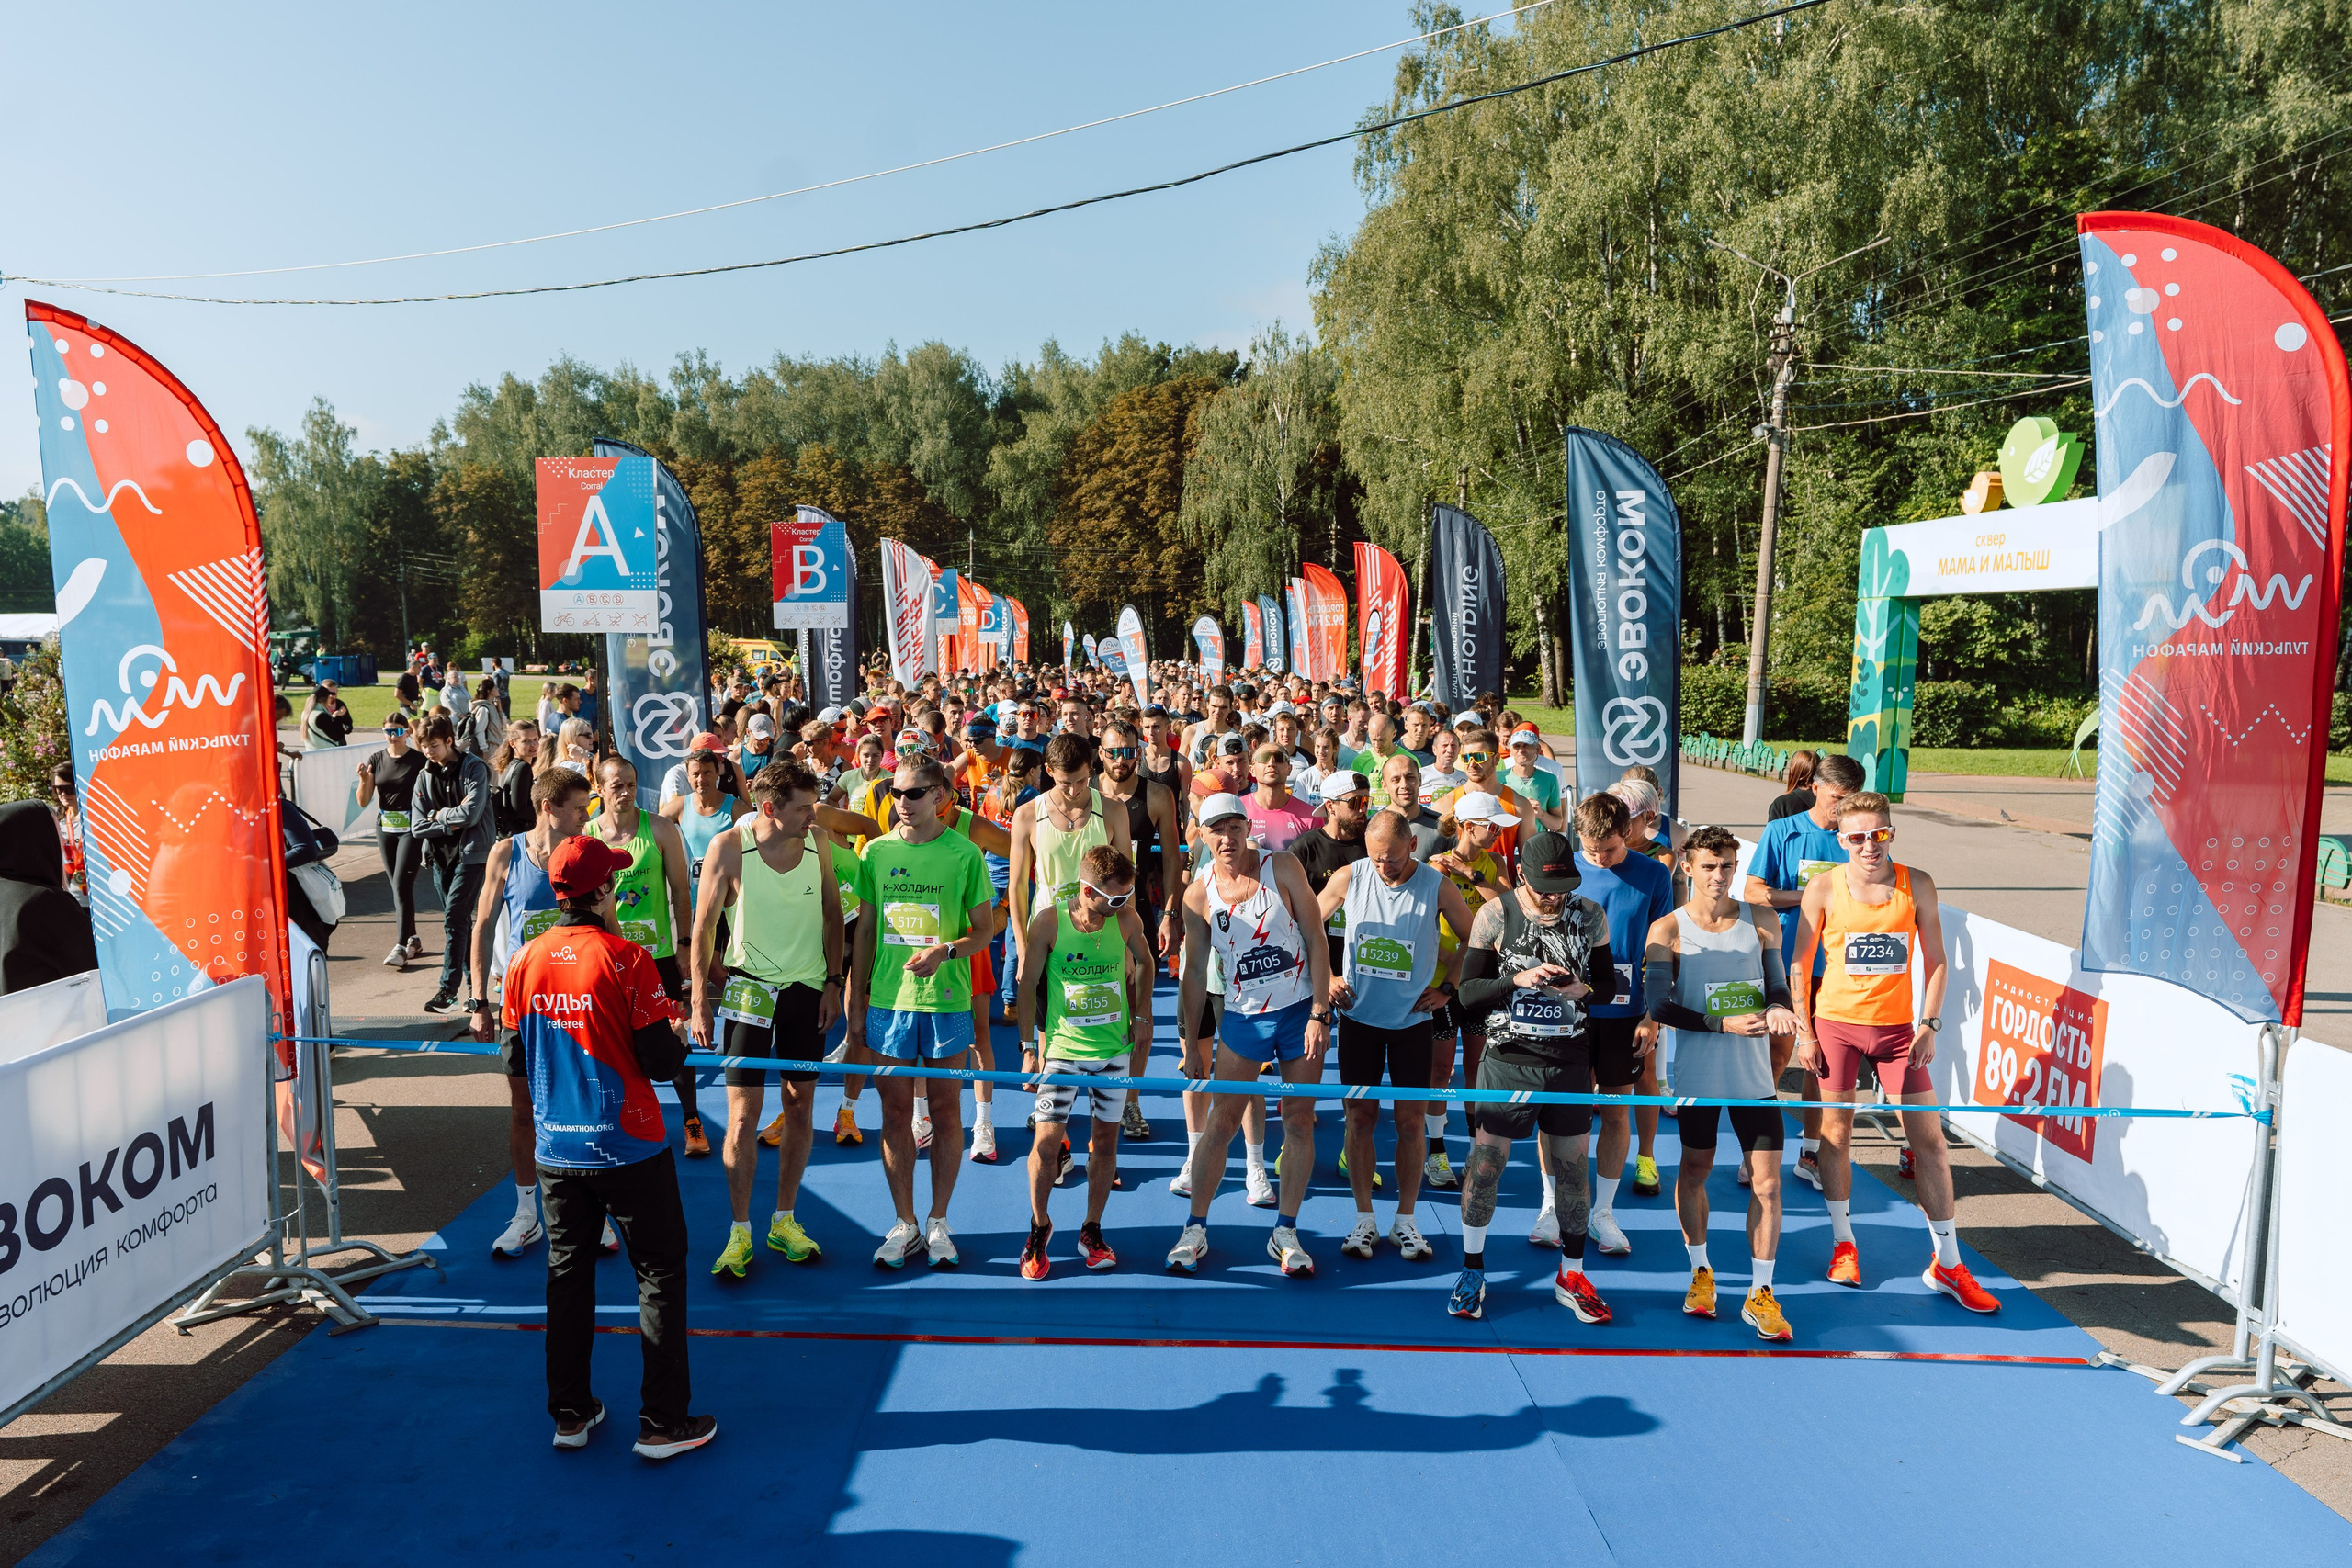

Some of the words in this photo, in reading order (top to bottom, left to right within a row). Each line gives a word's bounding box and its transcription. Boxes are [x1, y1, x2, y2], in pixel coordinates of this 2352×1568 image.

[568, 468, 615, 480] Кластер
[564, 495, 631, 576] A
[1975, 532, 2006, 549] сквер
[792, 545, 827, 595] B
[1937, 557, 1976, 576] МАМА
[1980, 555, 1990, 573] И
[1992, 549, 2050, 573] МАЛЫШ
[980, 609, 996, 629] D
[616, 867, 650, 880] ОЛДИНГ
[883, 883, 945, 894] К-ХОЛДИНГ
[528, 925, 534, 933] D
[898, 916, 922, 929] 5171
[622, 931, 646, 942] 5238
[1369, 948, 1399, 963] 5239
[1860, 945, 1894, 958] 7234
[1061, 962, 1119, 976] К-ХОЛДИНГ
[1248, 953, 1281, 973] 7105
[531, 993, 593, 1014] СУДЬЯ
[732, 991, 762, 1007] 5219
[1080, 996, 1108, 1010] 5155
[1723, 994, 1754, 1009] 5256
[1995, 979, 2094, 1025] РАДИОСТАНЦИЯ
[1527, 1003, 1562, 1019] 7268
[547, 1019, 584, 1030] referee
[1990, 995, 2092, 1070] ГОРДОСТЬ
[1984, 1040, 2043, 1108] 89.2
[2044, 1066, 2086, 1136] FM
[543, 1122, 615, 1133] TULAMARATHON.ORG
[0, 1101, 215, 1275] ВОКОМ
[0, 1247, 108, 1329] волюция
[117, 1182, 218, 1258] комфорта
